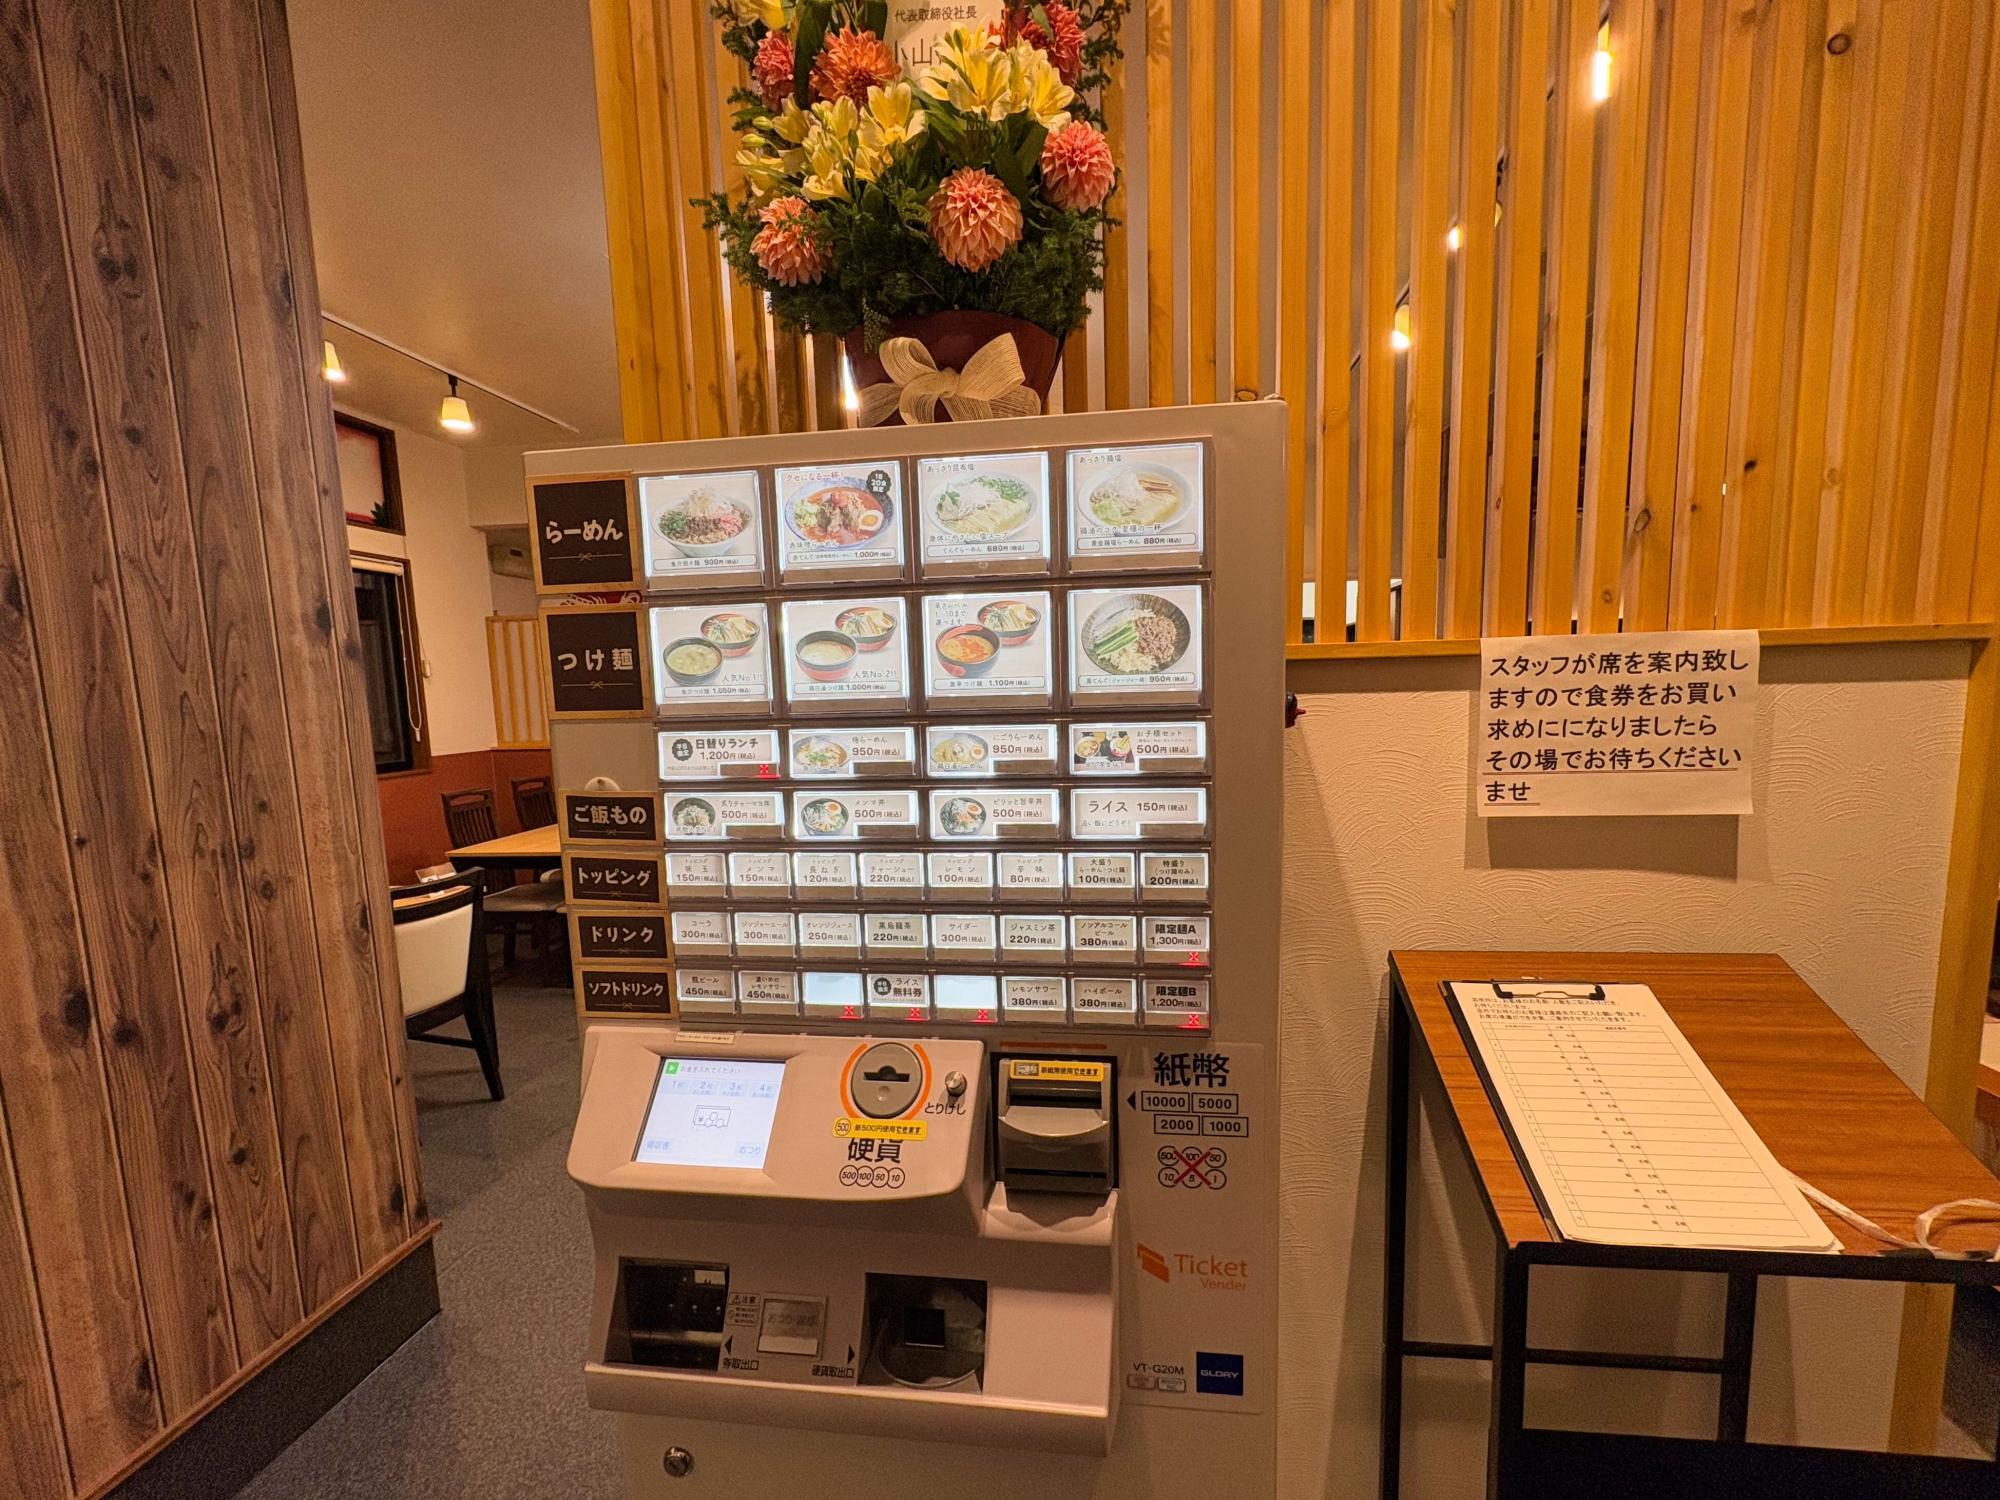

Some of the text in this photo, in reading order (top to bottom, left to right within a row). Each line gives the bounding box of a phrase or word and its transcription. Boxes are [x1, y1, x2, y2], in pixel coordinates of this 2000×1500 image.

[895, 5, 977, 22] 代表取締役社長
[546, 518, 624, 544] らーめん
[557, 648, 634, 672] つけ麺
[1489, 648, 1749, 677] スタッフが席を案内致し
[1488, 682, 1737, 710] ますので食券をお買い
[1487, 714, 1718, 741] 求めにになりましたら
[1136, 730, 1182, 738] お子様セット
[696, 738, 758, 750] 日替りランチ
[992, 744, 1043, 754] 950円(税込)
[1136, 744, 1190, 754] 500円(税込)
[700, 750, 756, 760] 1,200円(税込)
[852, 746, 900, 756] 950円(税込)
[1486, 745, 1742, 772] その場でお待ちください
[1485, 780, 1532, 802] ませ
[1088, 800, 1188, 814] ライス 150円(税込)
[574, 804, 648, 825] ご飯もの
[721, 810, 768, 820] 500円(税込)
[854, 809, 902, 818] 500円(税込)
[992, 808, 1043, 818] 500円(税込)
[810, 866, 840, 874] 長ねぎ
[578, 867, 652, 887] トッピング
[676, 874, 718, 882] 150円(税込)
[740, 874, 782, 882] 150円(税込)
[802, 874, 847, 882] 120円(税込)
[870, 874, 914, 882] 220円(税込)
[937, 874, 983, 883] 100円(税込)
[1010, 874, 1050, 884] 80円(税込)
[1078, 875, 1126, 884] 100円(税込)
[1150, 876, 1199, 886] 200円(税込)
[1010, 924, 1056, 932] ジャスミン茶
[1155, 924, 1197, 934] 限定麺A
[592, 926, 654, 943] ドリンク
[681, 930, 723, 939] 300円(税込)
[744, 931, 786, 940] 300円(税込)
[808, 932, 852, 940] 250円(税込)
[873, 934, 918, 942] 220円(税込)
[940, 934, 986, 942] 300円(税込)
[1010, 935, 1056, 944] 220円(税込)
[1080, 938, 1128, 946] 380円(税込)
[1150, 936, 1202, 946] 1,300円(税込)
[896, 977, 920, 986] ライス
[588, 981, 664, 997] ソフトドリンク
[685, 986, 727, 996] 450円(税込)
[892, 987, 922, 998] 無料券
[1083, 986, 1122, 995] ハイボール
[1156, 986, 1196, 996] 限定麺B
[747, 990, 790, 1000] 450円(税込)
[1011, 997, 1058, 1006] 380円(税込)
[1080, 998, 1126, 1008] 380円(税込)
[1150, 998, 1202, 1008] 1,200円(税込)
[1153, 1052, 1230, 1088] 紙幣
[1146, 1096, 1232, 1110] 10000 5000
[924, 1102, 966, 1116] とりけし
[836, 1122, 922, 1136] 500 新500円使用できます
[1160, 1120, 1242, 1132] 2000 1000
[842, 1171, 900, 1182] 500 100 50 10
[1164, 1172, 1175, 1182] 10
[1188, 1174, 1196, 1182] 5
[1174, 1254, 1248, 1278] Ticket
[1200, 1278, 1247, 1292] Vender
[722, 1358, 760, 1371] 券取出口
[1132, 1362, 1184, 1375] VT-G20M
[812, 1364, 854, 1379] 硬貨取出口
[1200, 1368, 1240, 1379] GLORY
